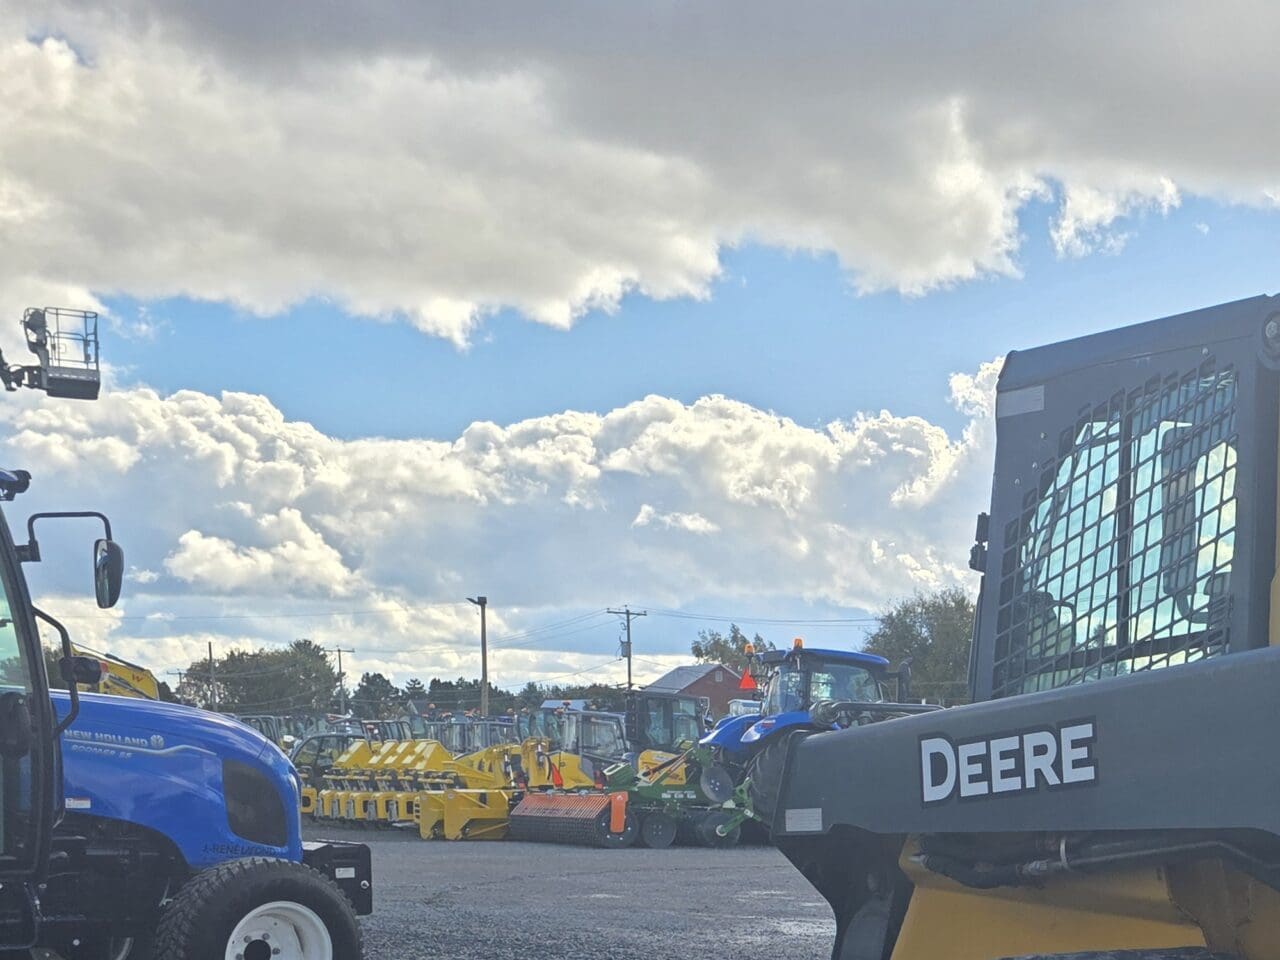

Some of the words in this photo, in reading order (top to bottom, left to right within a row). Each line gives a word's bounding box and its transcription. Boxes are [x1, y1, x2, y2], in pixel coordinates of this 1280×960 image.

[63, 729, 92, 740] NEW
[94, 732, 149, 746] HOLLAND
[920, 723, 1095, 802] DEERE
